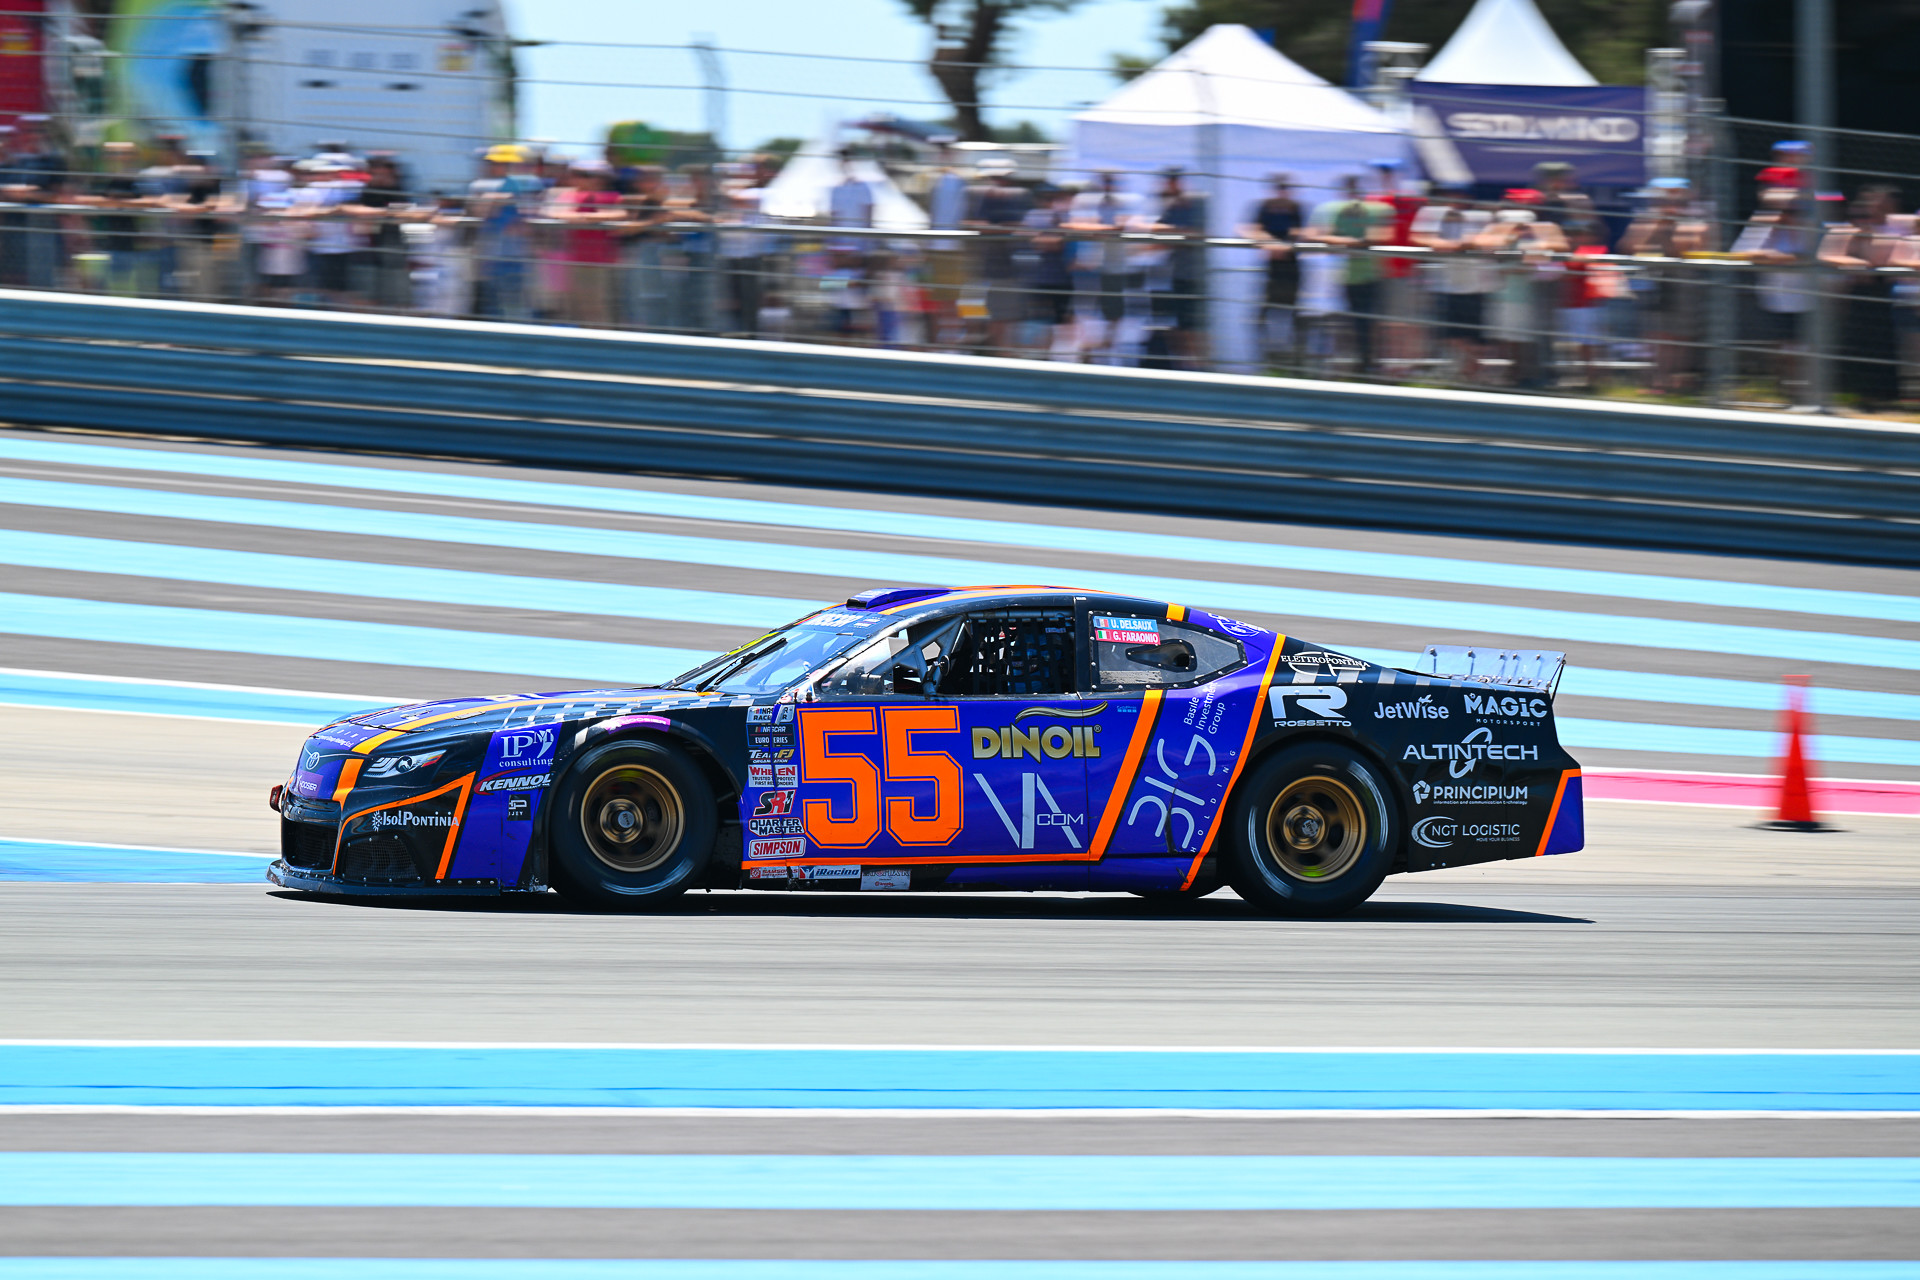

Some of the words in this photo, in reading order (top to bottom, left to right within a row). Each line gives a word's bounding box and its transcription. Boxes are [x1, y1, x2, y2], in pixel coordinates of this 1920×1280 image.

[1110, 619, 1119, 629] U.
[1120, 620, 1153, 631] DELSAUX
[1112, 631, 1121, 641] G.
[1121, 631, 1158, 643] FARAONIO
[1184, 696, 1199, 725] Basile
[1374, 701, 1450, 719] JetWise
[1208, 702, 1226, 734] Group
[1274, 719, 1352, 728] ROSSETTO
[1476, 718, 1541, 727] MOTORSPORT
[1403, 744, 1539, 760] ALTINTECH
[499, 758, 554, 768] consulting
[749, 766, 796, 776] WHEEN
[479, 773, 552, 792] KENNOL
[797, 706, 964, 849] 55
[1433, 785, 1528, 799] PRINCIPIUM
[1036, 813, 1084, 826] COM
[758, 825, 803, 836] MASTER
[1462, 824, 1520, 836] LOGISTIC
[753, 840, 801, 856] SIMPSON
[815, 867, 860, 877] iRacing
